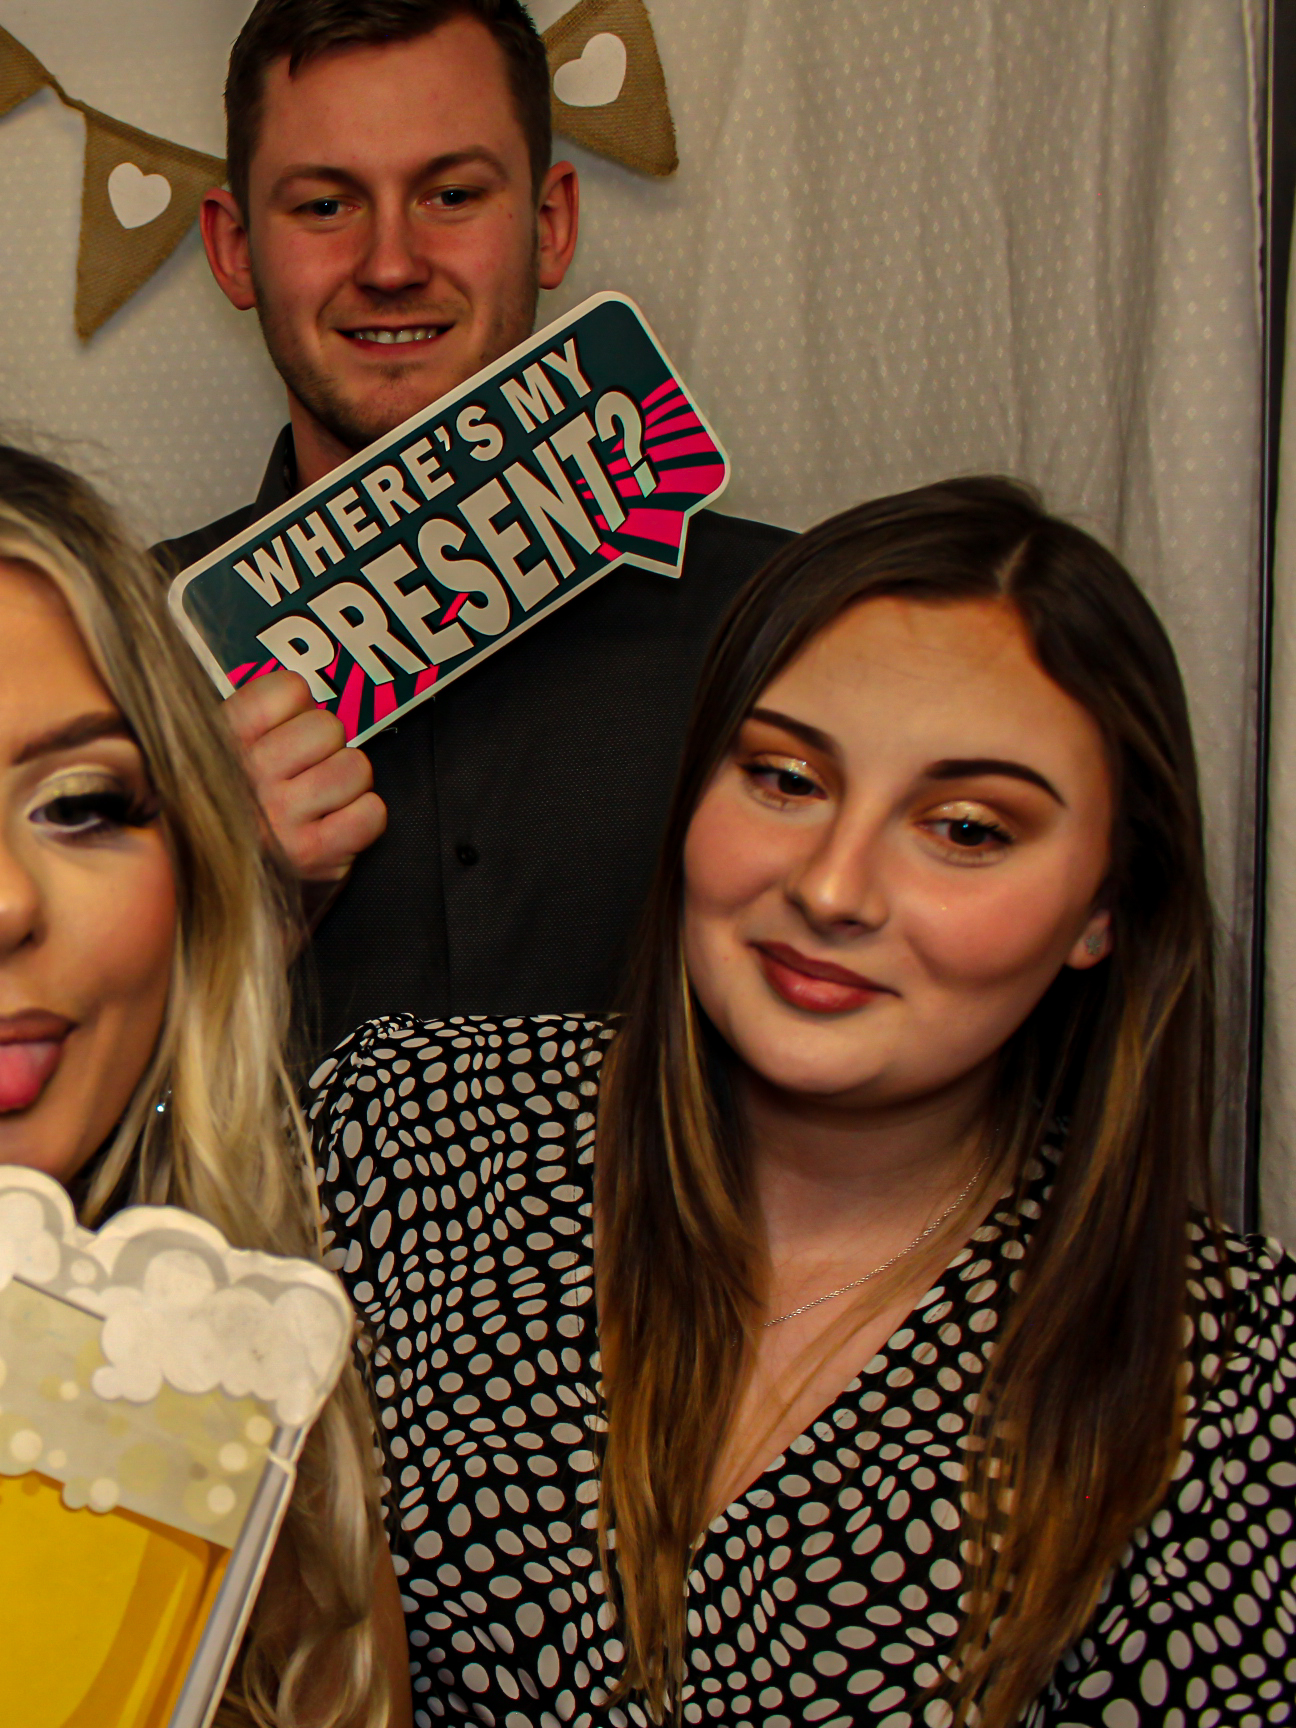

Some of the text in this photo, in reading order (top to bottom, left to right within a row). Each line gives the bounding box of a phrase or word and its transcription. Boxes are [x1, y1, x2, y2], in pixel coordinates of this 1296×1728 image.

[233, 338, 593, 607] WHERE'S MY
[256, 390, 657, 703] PRESENT?
